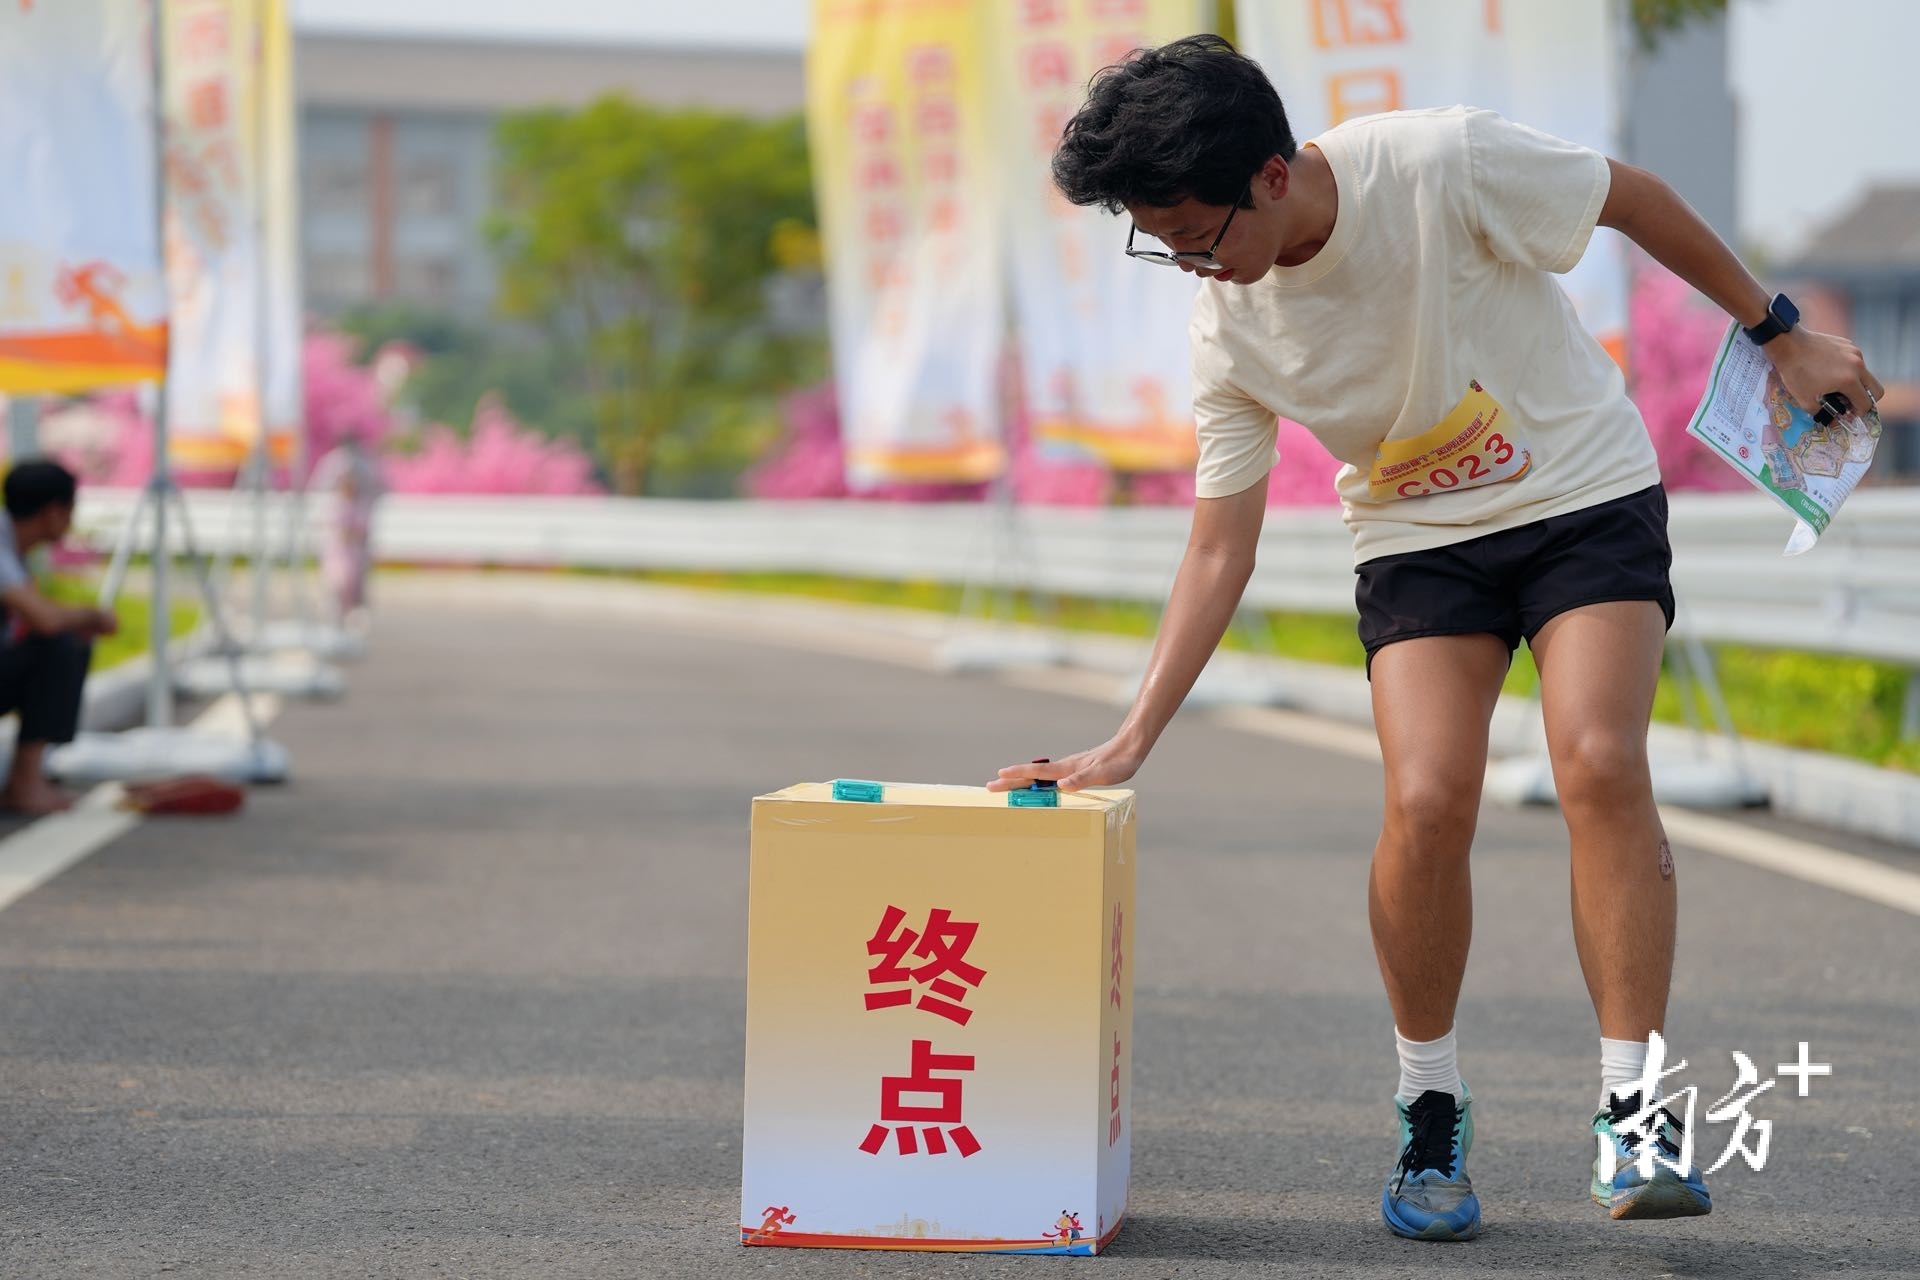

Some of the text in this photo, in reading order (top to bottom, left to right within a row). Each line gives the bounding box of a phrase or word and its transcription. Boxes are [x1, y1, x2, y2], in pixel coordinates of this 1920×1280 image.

[1397, 432, 1514, 497] C023
[858, 904, 988, 1158] 终点
[1109, 901, 1123, 1148] 终点
